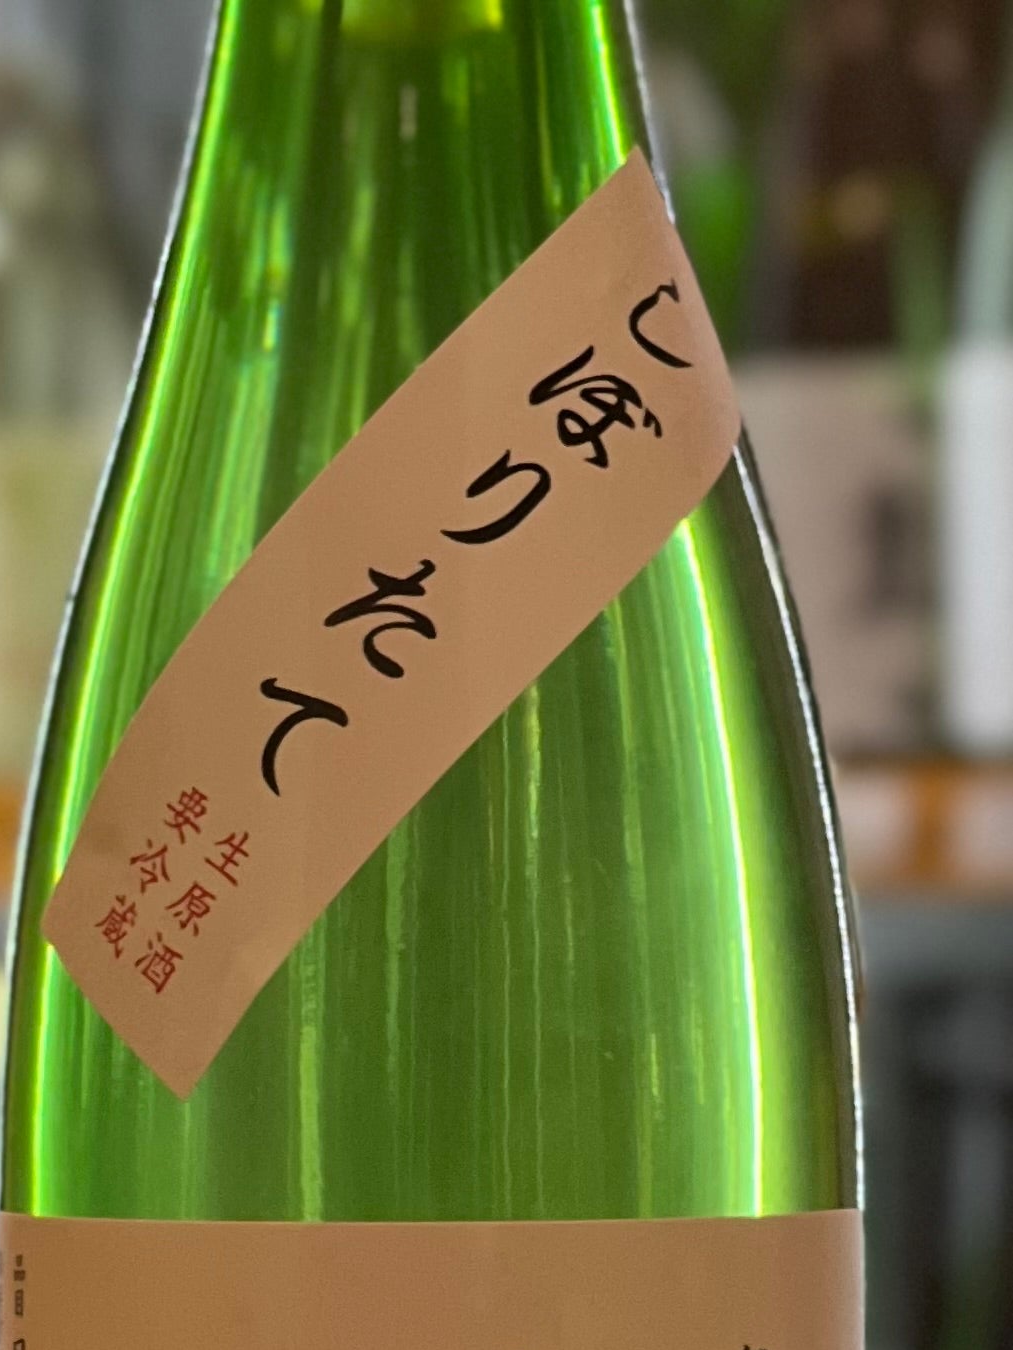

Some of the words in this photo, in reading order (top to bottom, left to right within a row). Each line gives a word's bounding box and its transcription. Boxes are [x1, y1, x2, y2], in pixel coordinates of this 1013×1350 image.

[260, 279, 693, 797] しぼりたて
[94, 786, 208, 960] 要冷蔵
[134, 831, 250, 995] 生原酒
